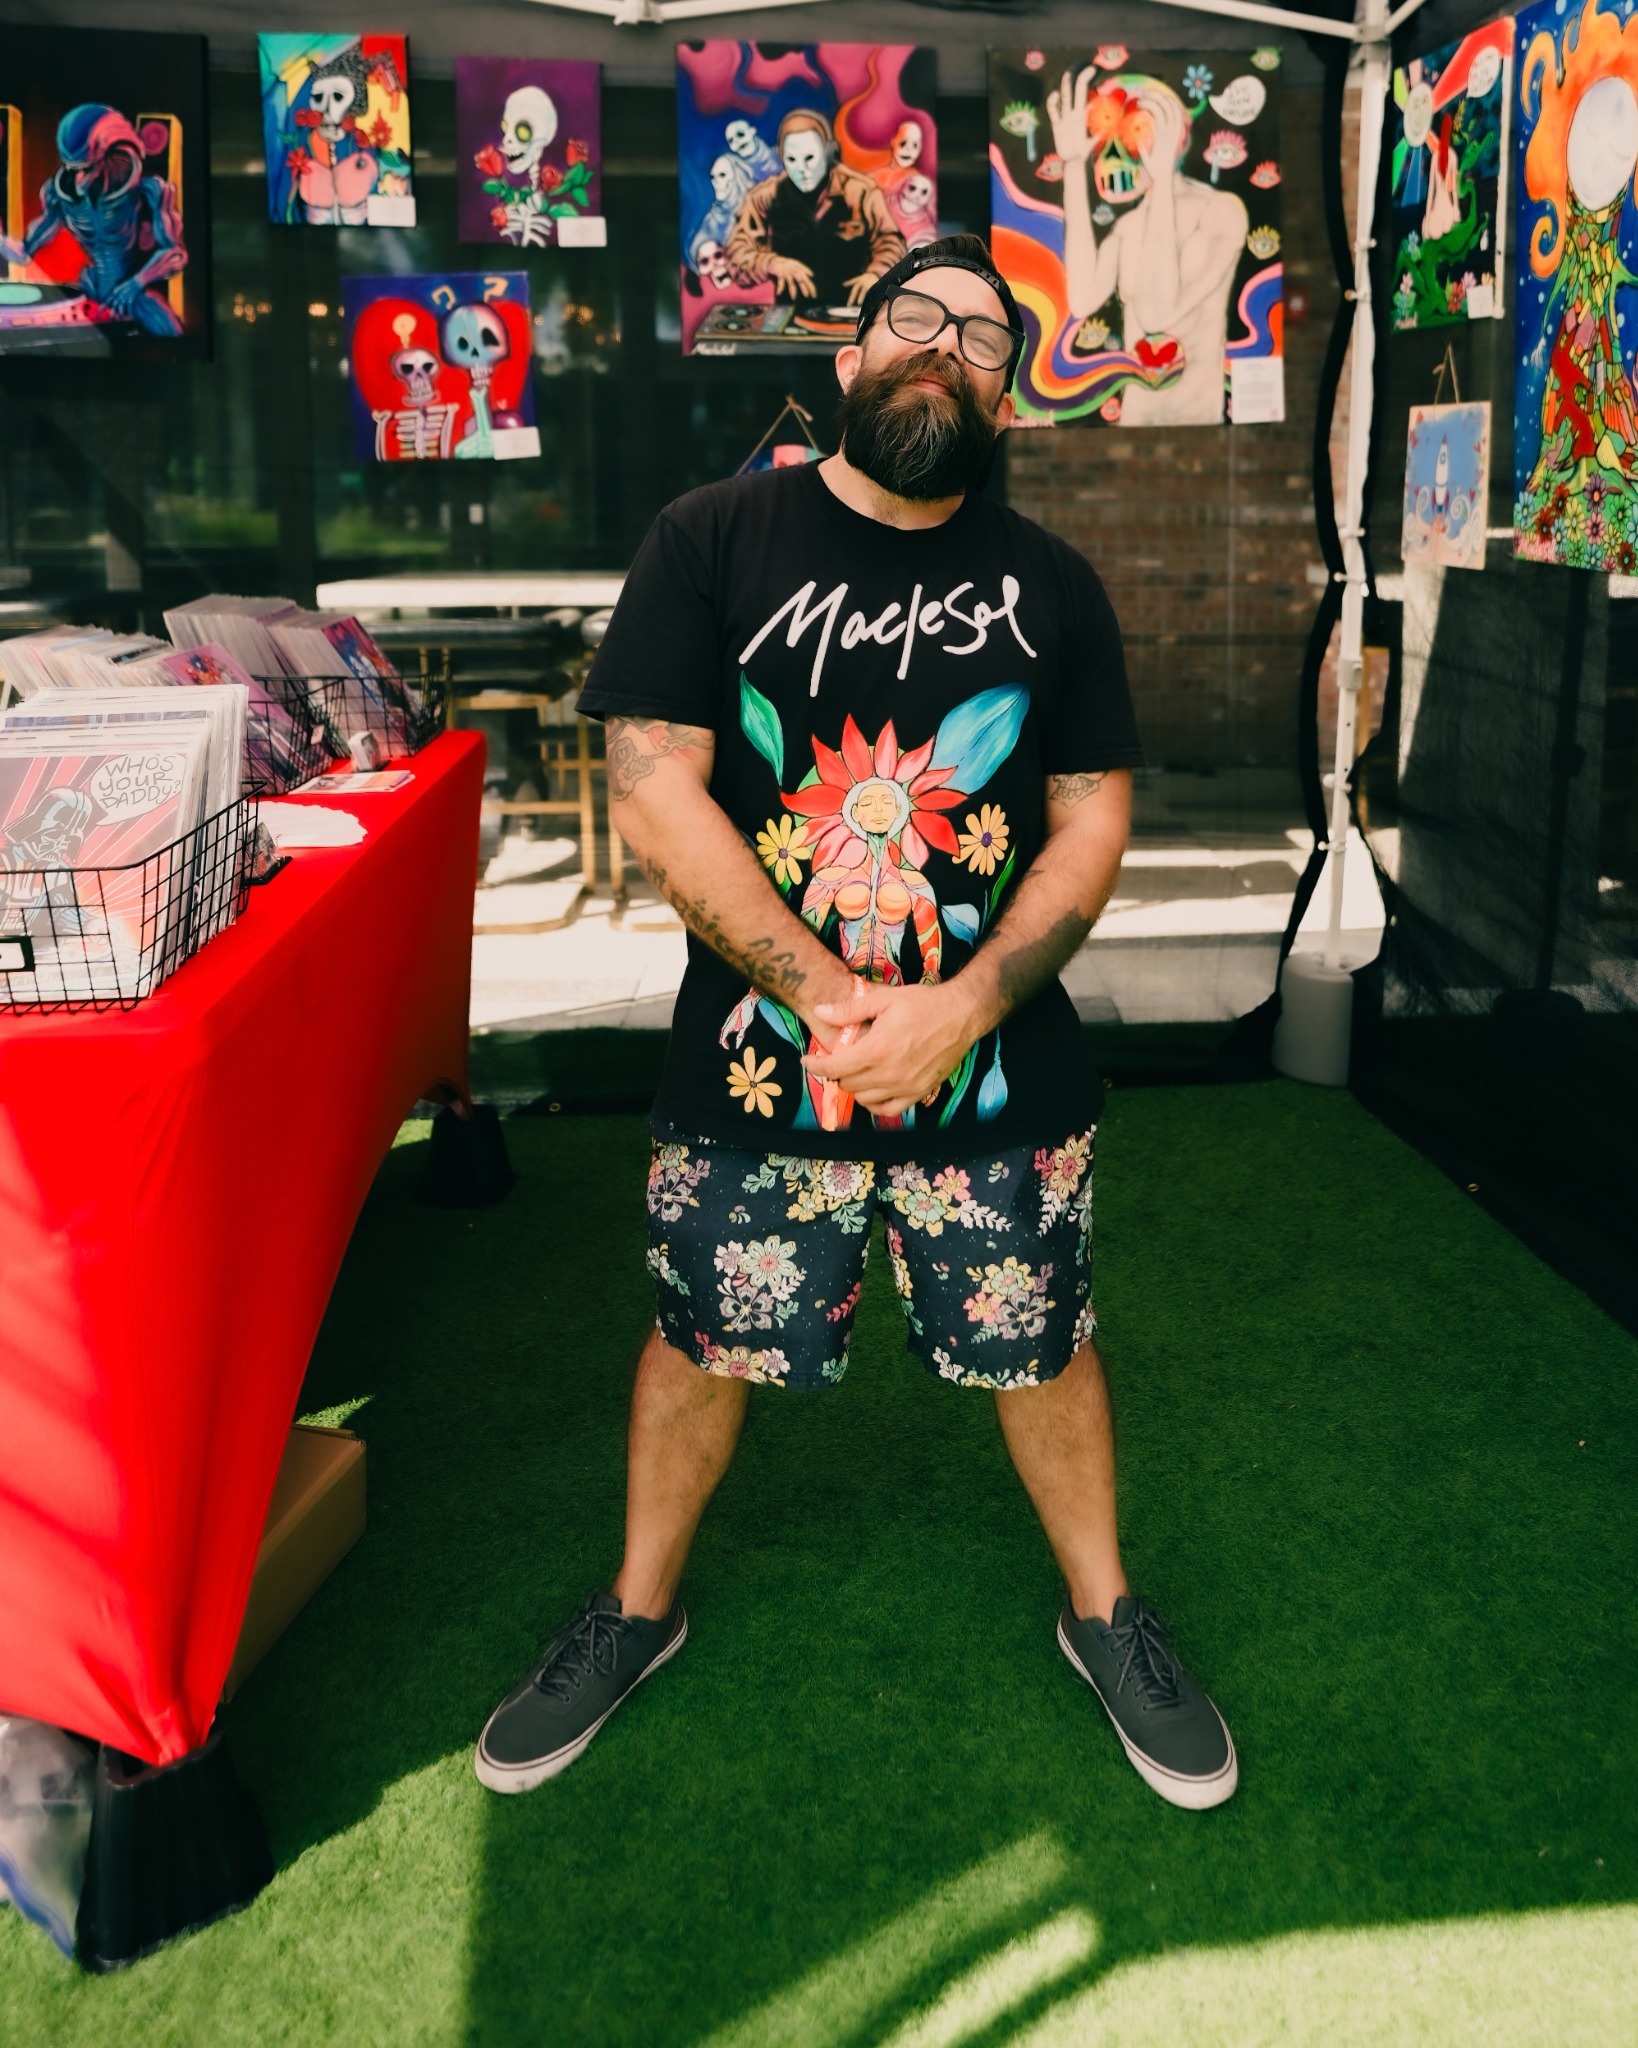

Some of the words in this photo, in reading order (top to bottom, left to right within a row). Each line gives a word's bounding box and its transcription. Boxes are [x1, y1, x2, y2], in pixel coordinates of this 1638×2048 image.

[105, 753, 176, 777] WHO'S
[98, 771, 173, 797] YOUR
[99, 779, 181, 809] DADDY?
